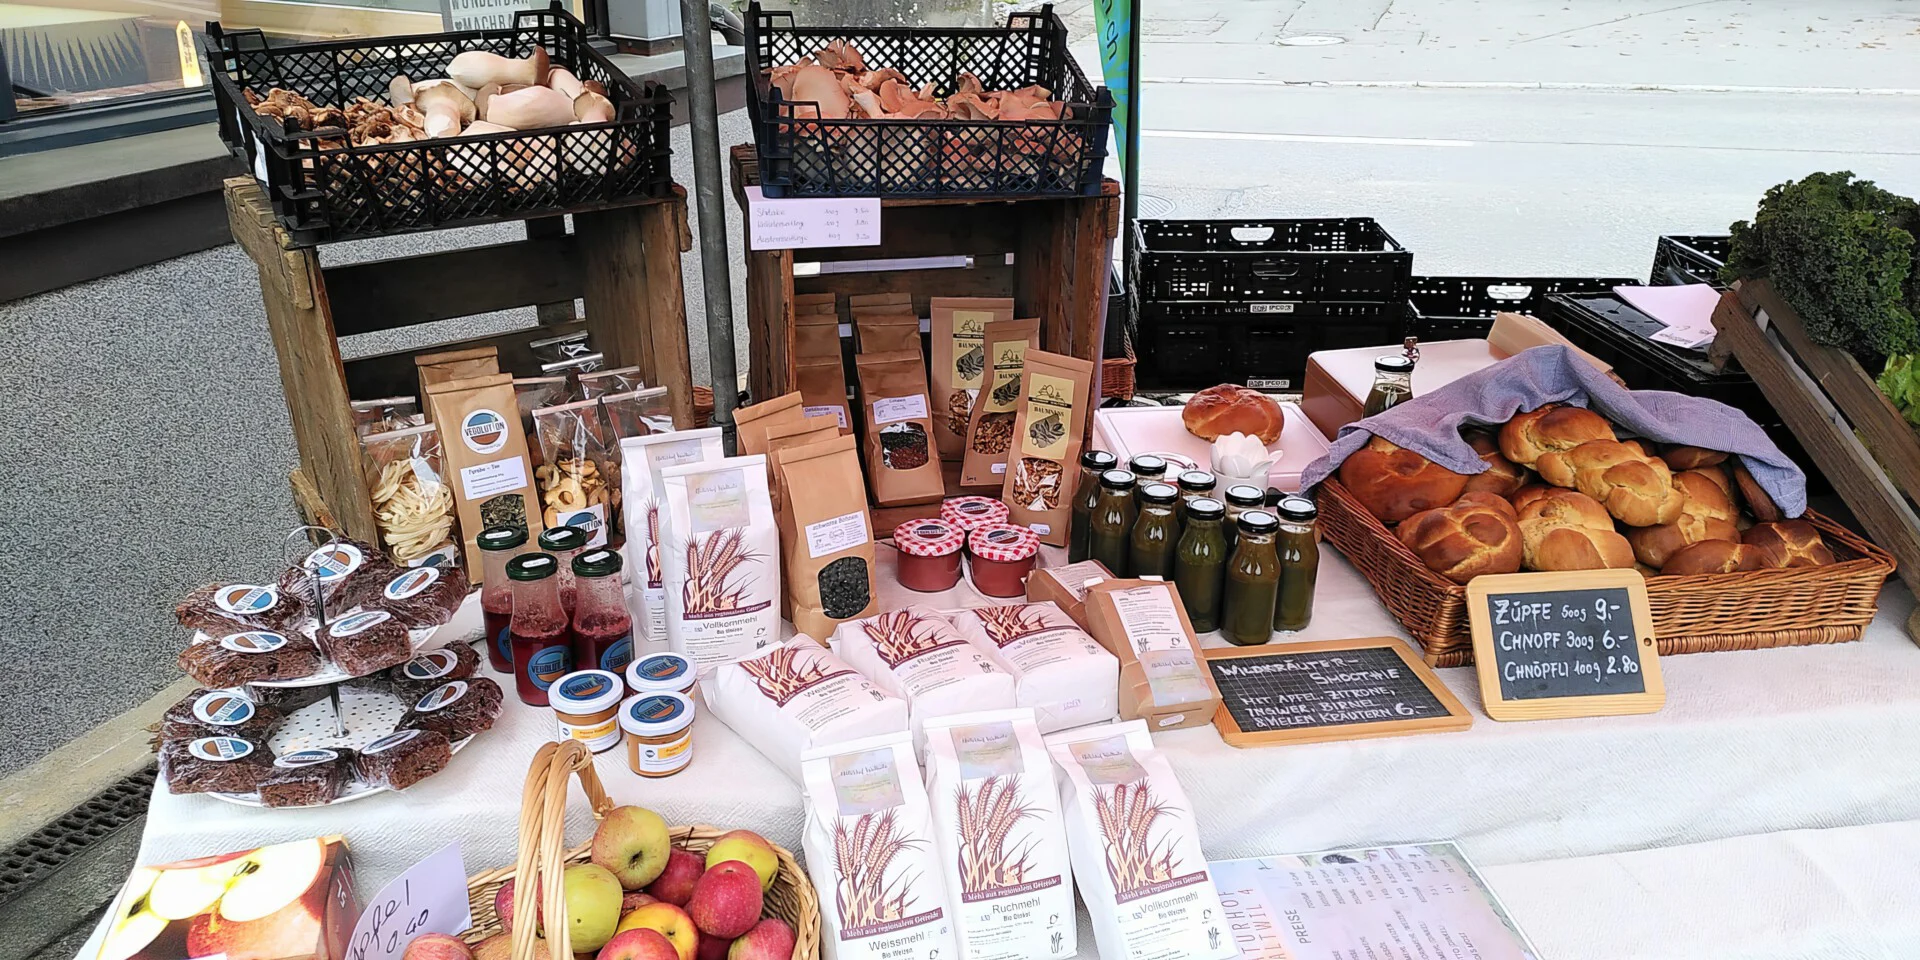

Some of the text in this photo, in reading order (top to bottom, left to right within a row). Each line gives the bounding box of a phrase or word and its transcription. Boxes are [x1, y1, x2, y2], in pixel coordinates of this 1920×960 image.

[702, 615, 758, 630] Vollkornmehl
[1561, 605, 1586, 622] 500g
[1500, 631, 1562, 651] CHNOPF
[1566, 630, 1594, 650] 300g
[1217, 658, 1359, 676] WILDKRÄUTER-
[1504, 655, 1639, 683] CHNÖPFLI 100g 2.80
[1309, 668, 1400, 685] SMOOTHIE
[1241, 695, 1272, 706] MIT
[1319, 700, 1381, 712] BIRNEL
[1319, 709, 1391, 724] KRÄUTERN
[967, 892, 985, 901] Mehl
[992, 896, 1041, 914] Ruchmehl
[1139, 891, 1199, 914] Vollkornmehl
[386, 908, 429, 954] 0.40
[1285, 909, 1312, 944] PREISE
[868, 931, 925, 952] Weissmehl
